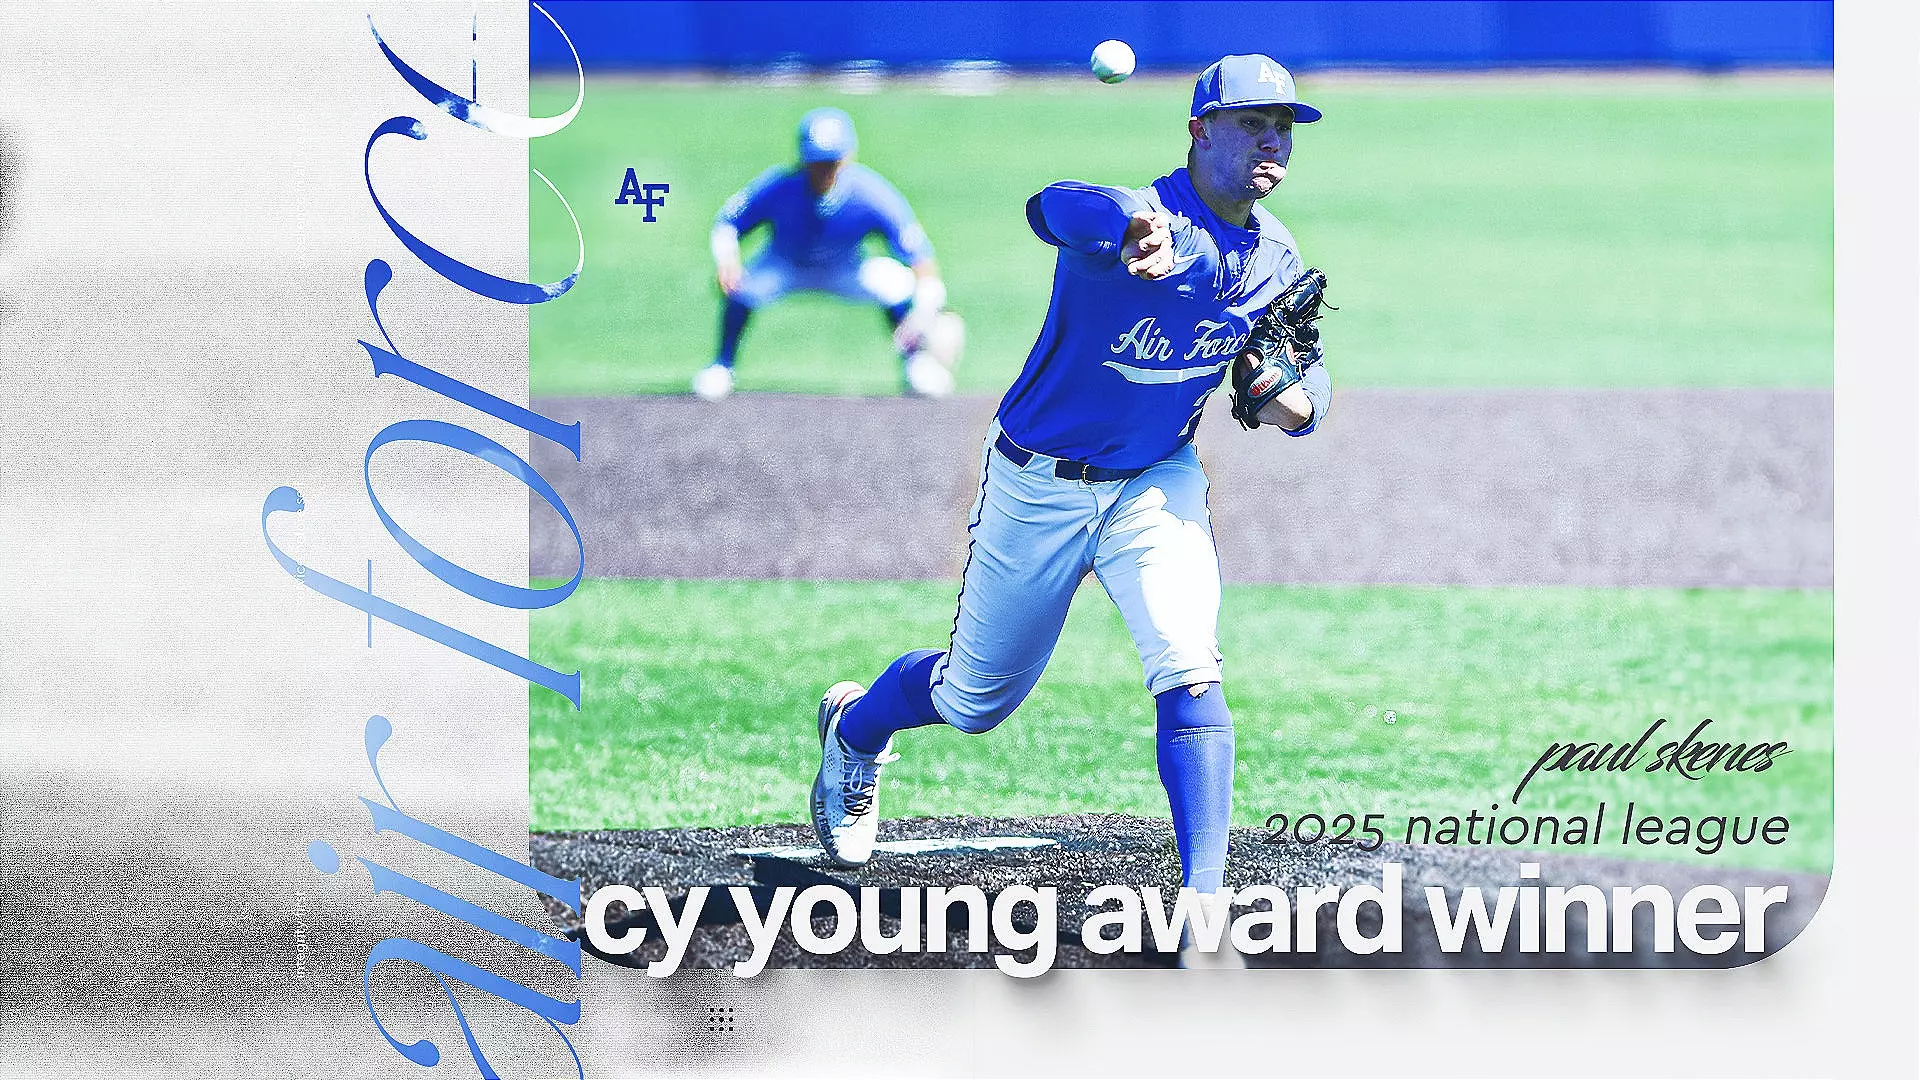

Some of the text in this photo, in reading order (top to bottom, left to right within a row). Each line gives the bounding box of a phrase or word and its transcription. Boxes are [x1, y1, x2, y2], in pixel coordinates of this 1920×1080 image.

[1257, 62, 1287, 97] AF
[1110, 317, 1248, 361] Air Forc
